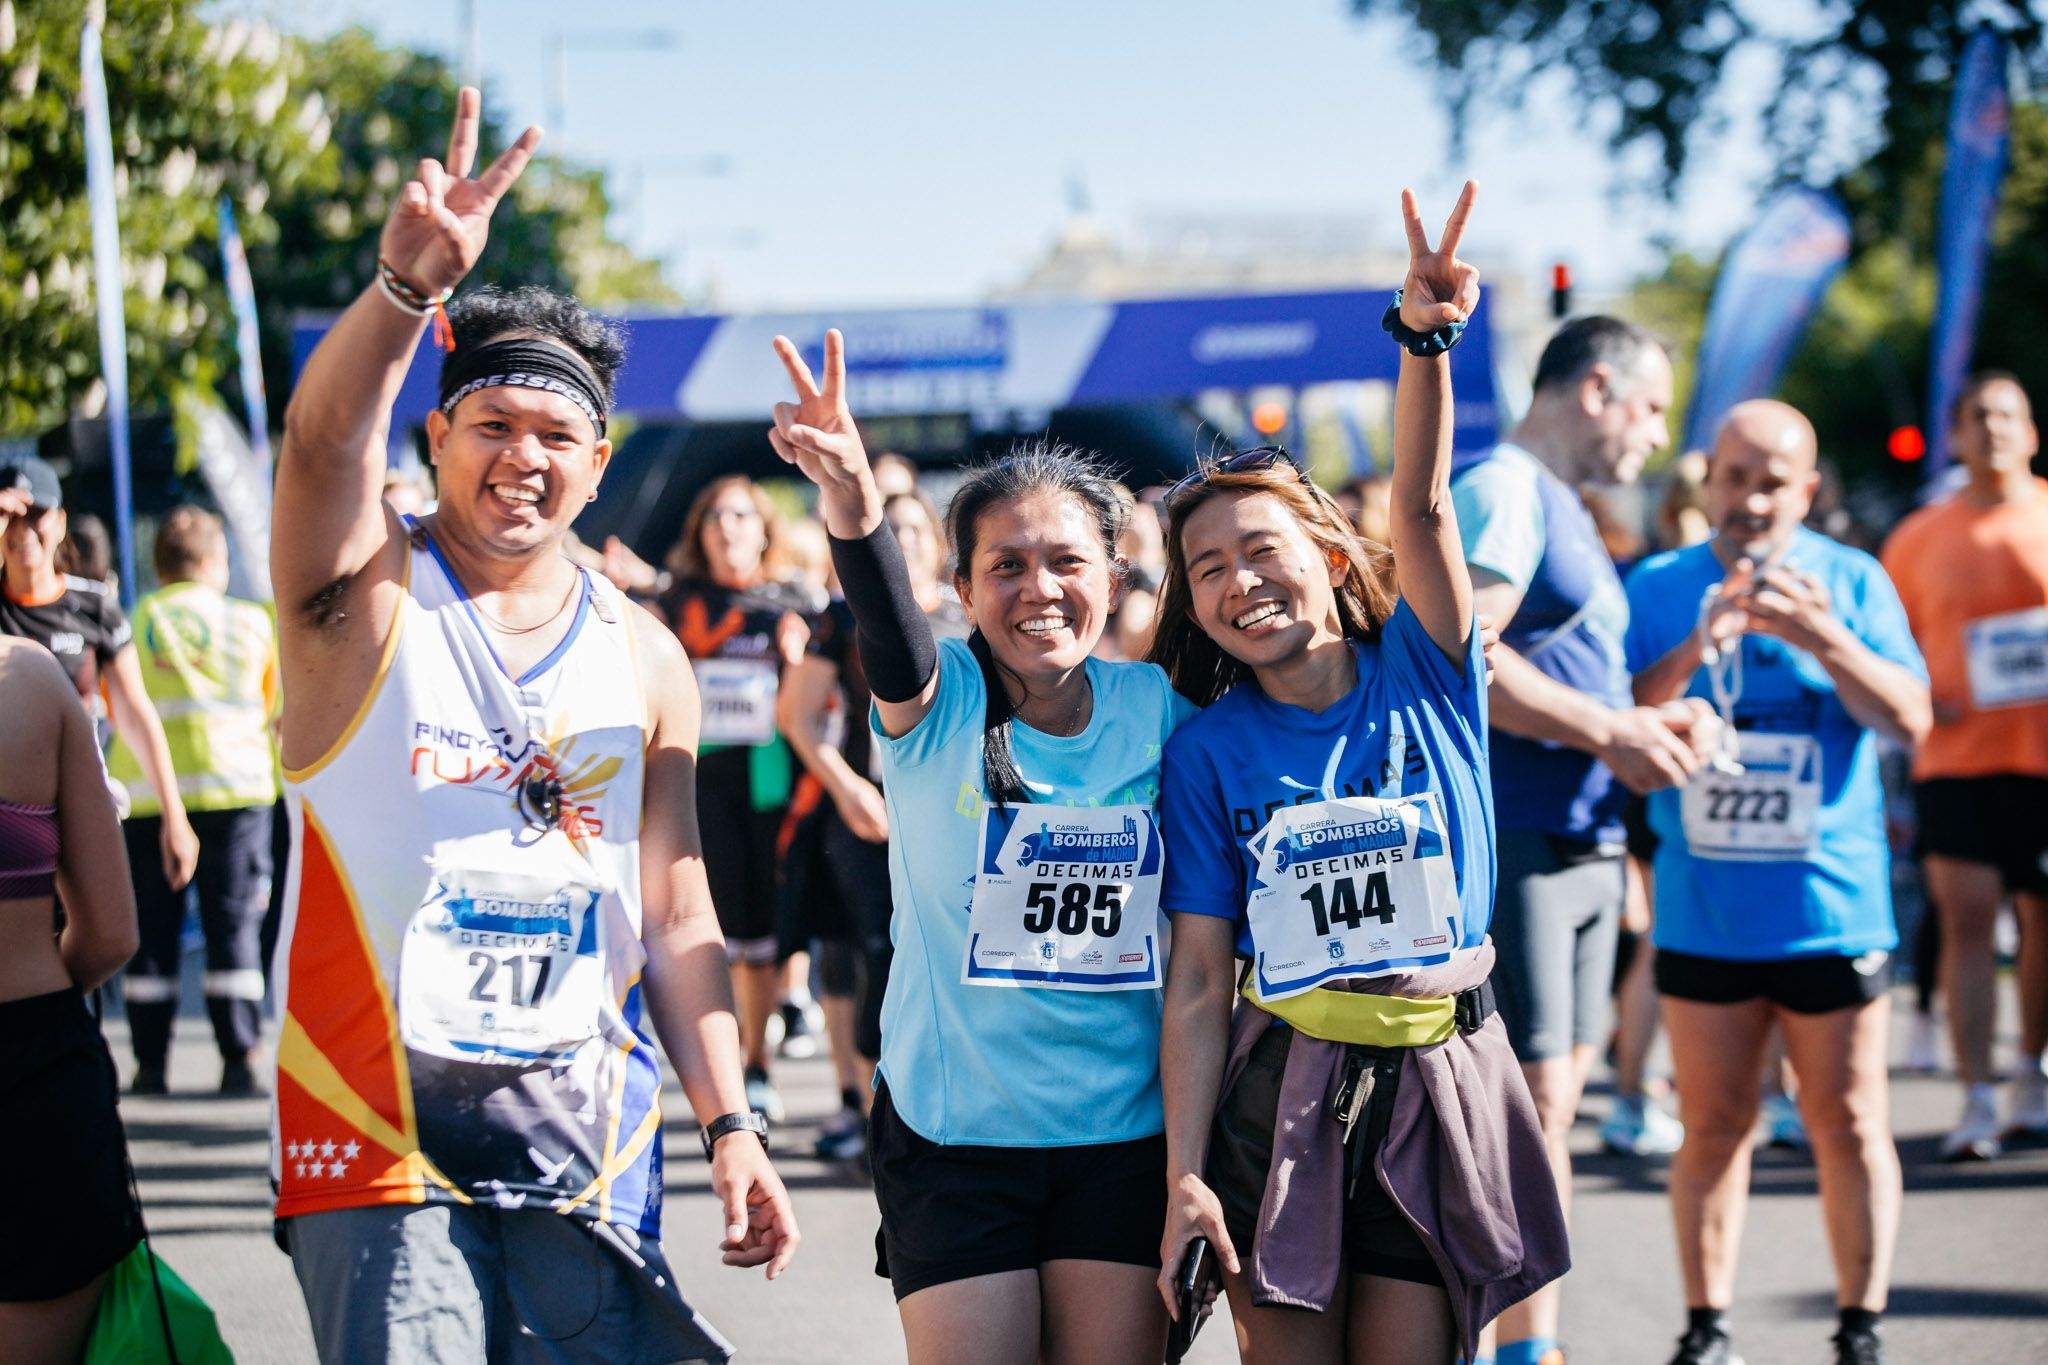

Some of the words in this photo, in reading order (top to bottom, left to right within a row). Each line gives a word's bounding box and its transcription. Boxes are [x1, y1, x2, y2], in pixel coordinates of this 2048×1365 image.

[1707, 786, 1790, 824] 2223
[1055, 824, 1090, 832] CARRERA
[1300, 819, 1336, 831] CARRERA
[1301, 818, 1401, 846] BOMBEROS
[1052, 832, 1136, 847] BOMBEROS
[1341, 840, 1356, 854] de
[1358, 832, 1404, 851] MADRID
[1086, 850, 1099, 861] de
[1102, 847, 1136, 861] MADRID
[1295, 849, 1404, 880] DECIMAS
[1036, 863, 1133, 879] DECIMAS
[473, 900, 569, 920] BOMBEROS
[1023, 882, 1123, 938] 585
[1300, 871, 1396, 937] 144
[461, 932, 570, 952] DECIMAS
[469, 951, 553, 1009] 217
